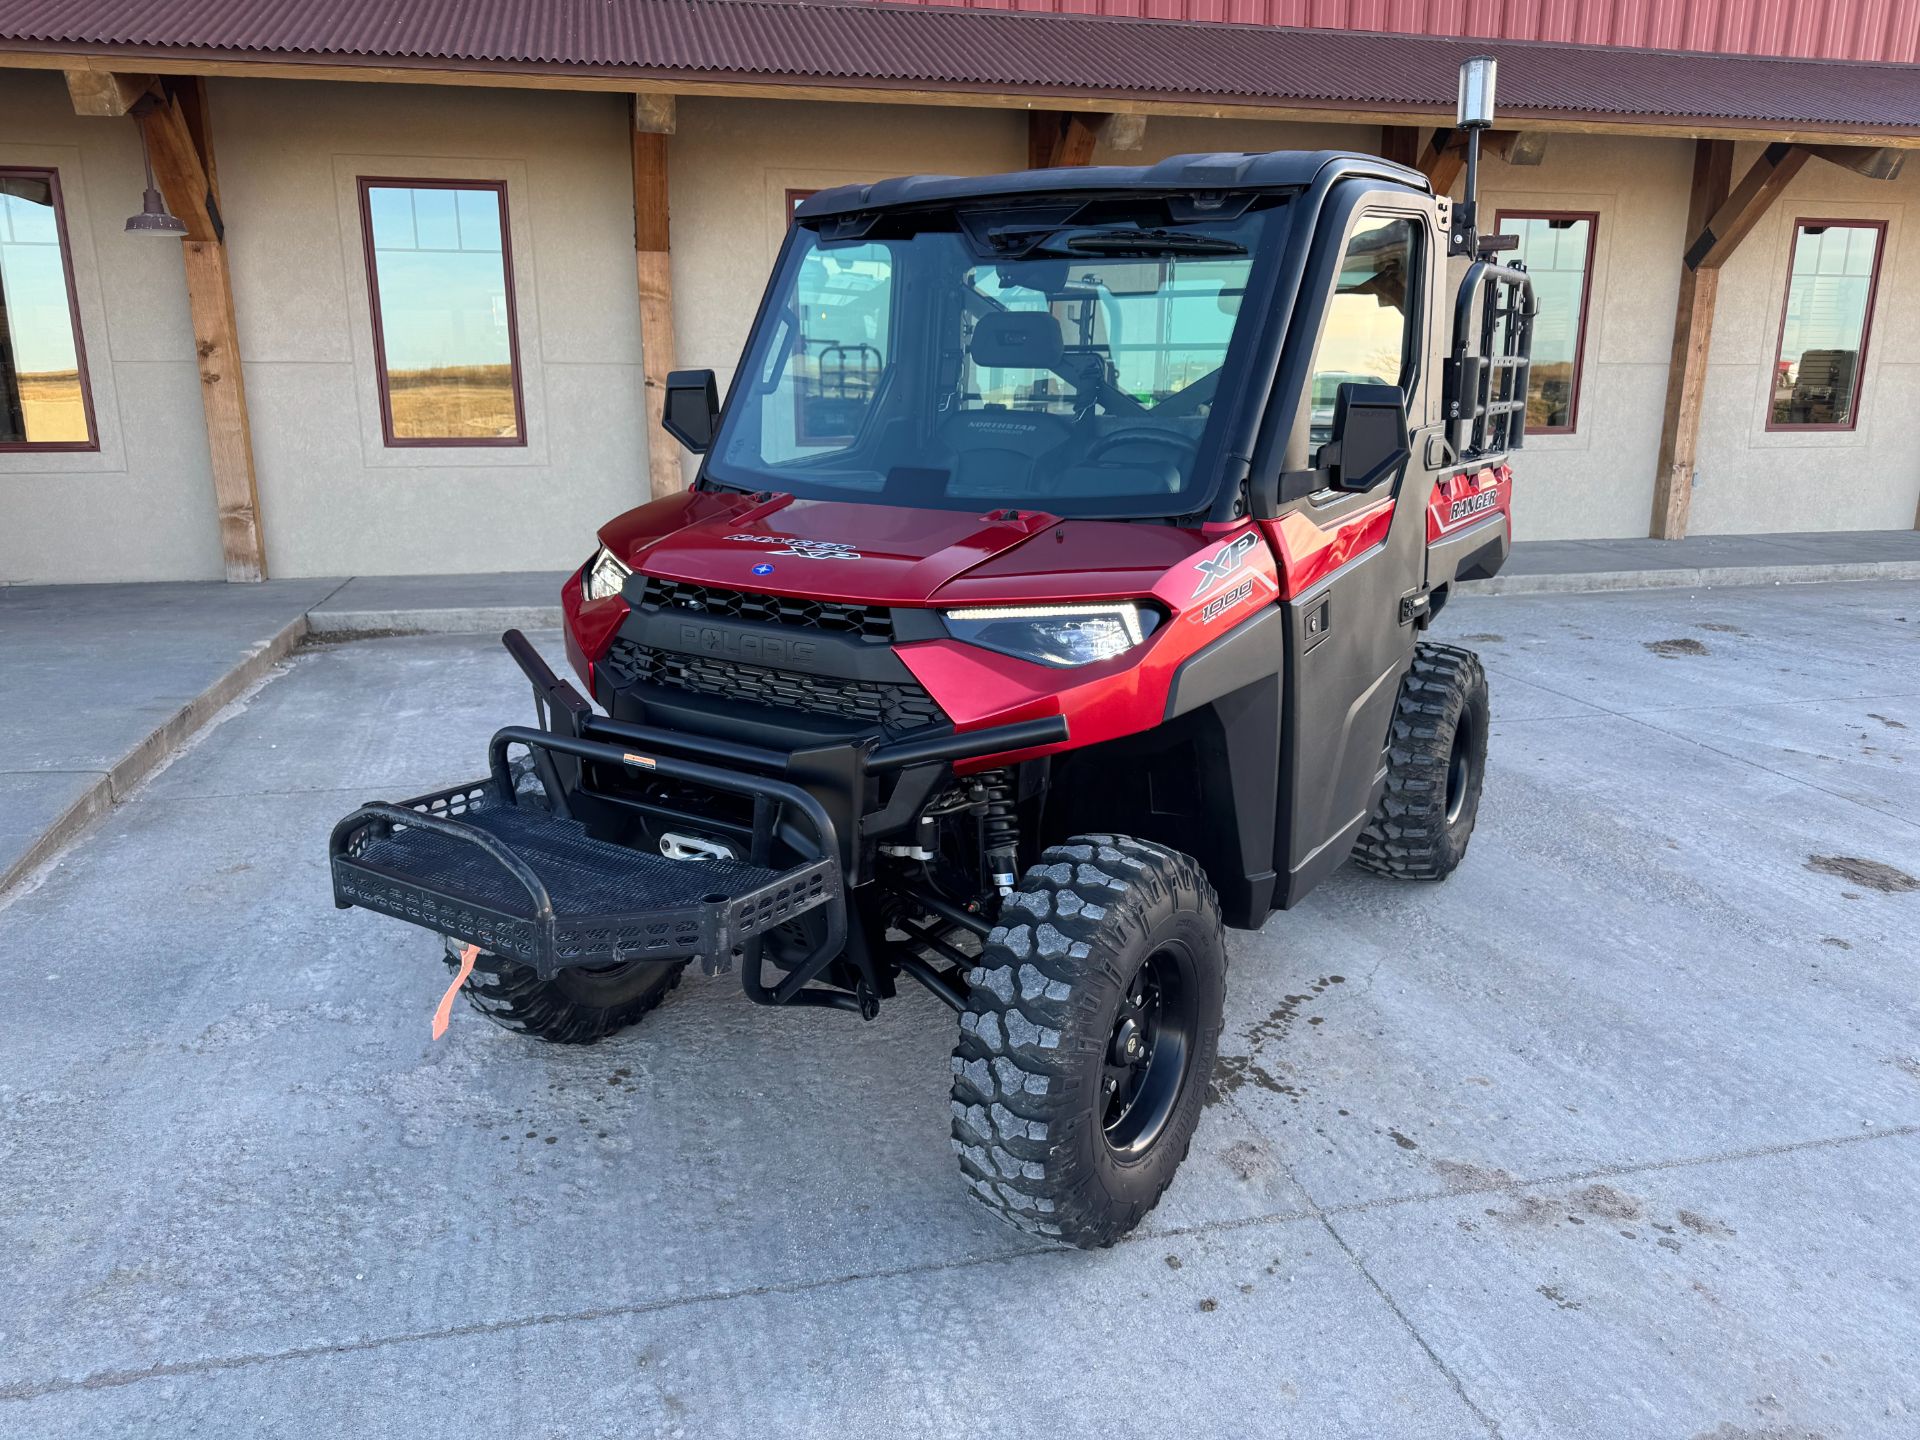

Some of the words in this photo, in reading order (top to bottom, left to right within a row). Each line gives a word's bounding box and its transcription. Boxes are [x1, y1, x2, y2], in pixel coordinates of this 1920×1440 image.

[967, 421, 1038, 432] NORTHSTAR
[1448, 488, 1497, 523] RANGER
[722, 534, 857, 551] RANGER
[763, 545, 862, 560] XP
[1191, 531, 1259, 598] XP
[1202, 579, 1253, 620] 1000
[679, 623, 817, 666] POLARIS
